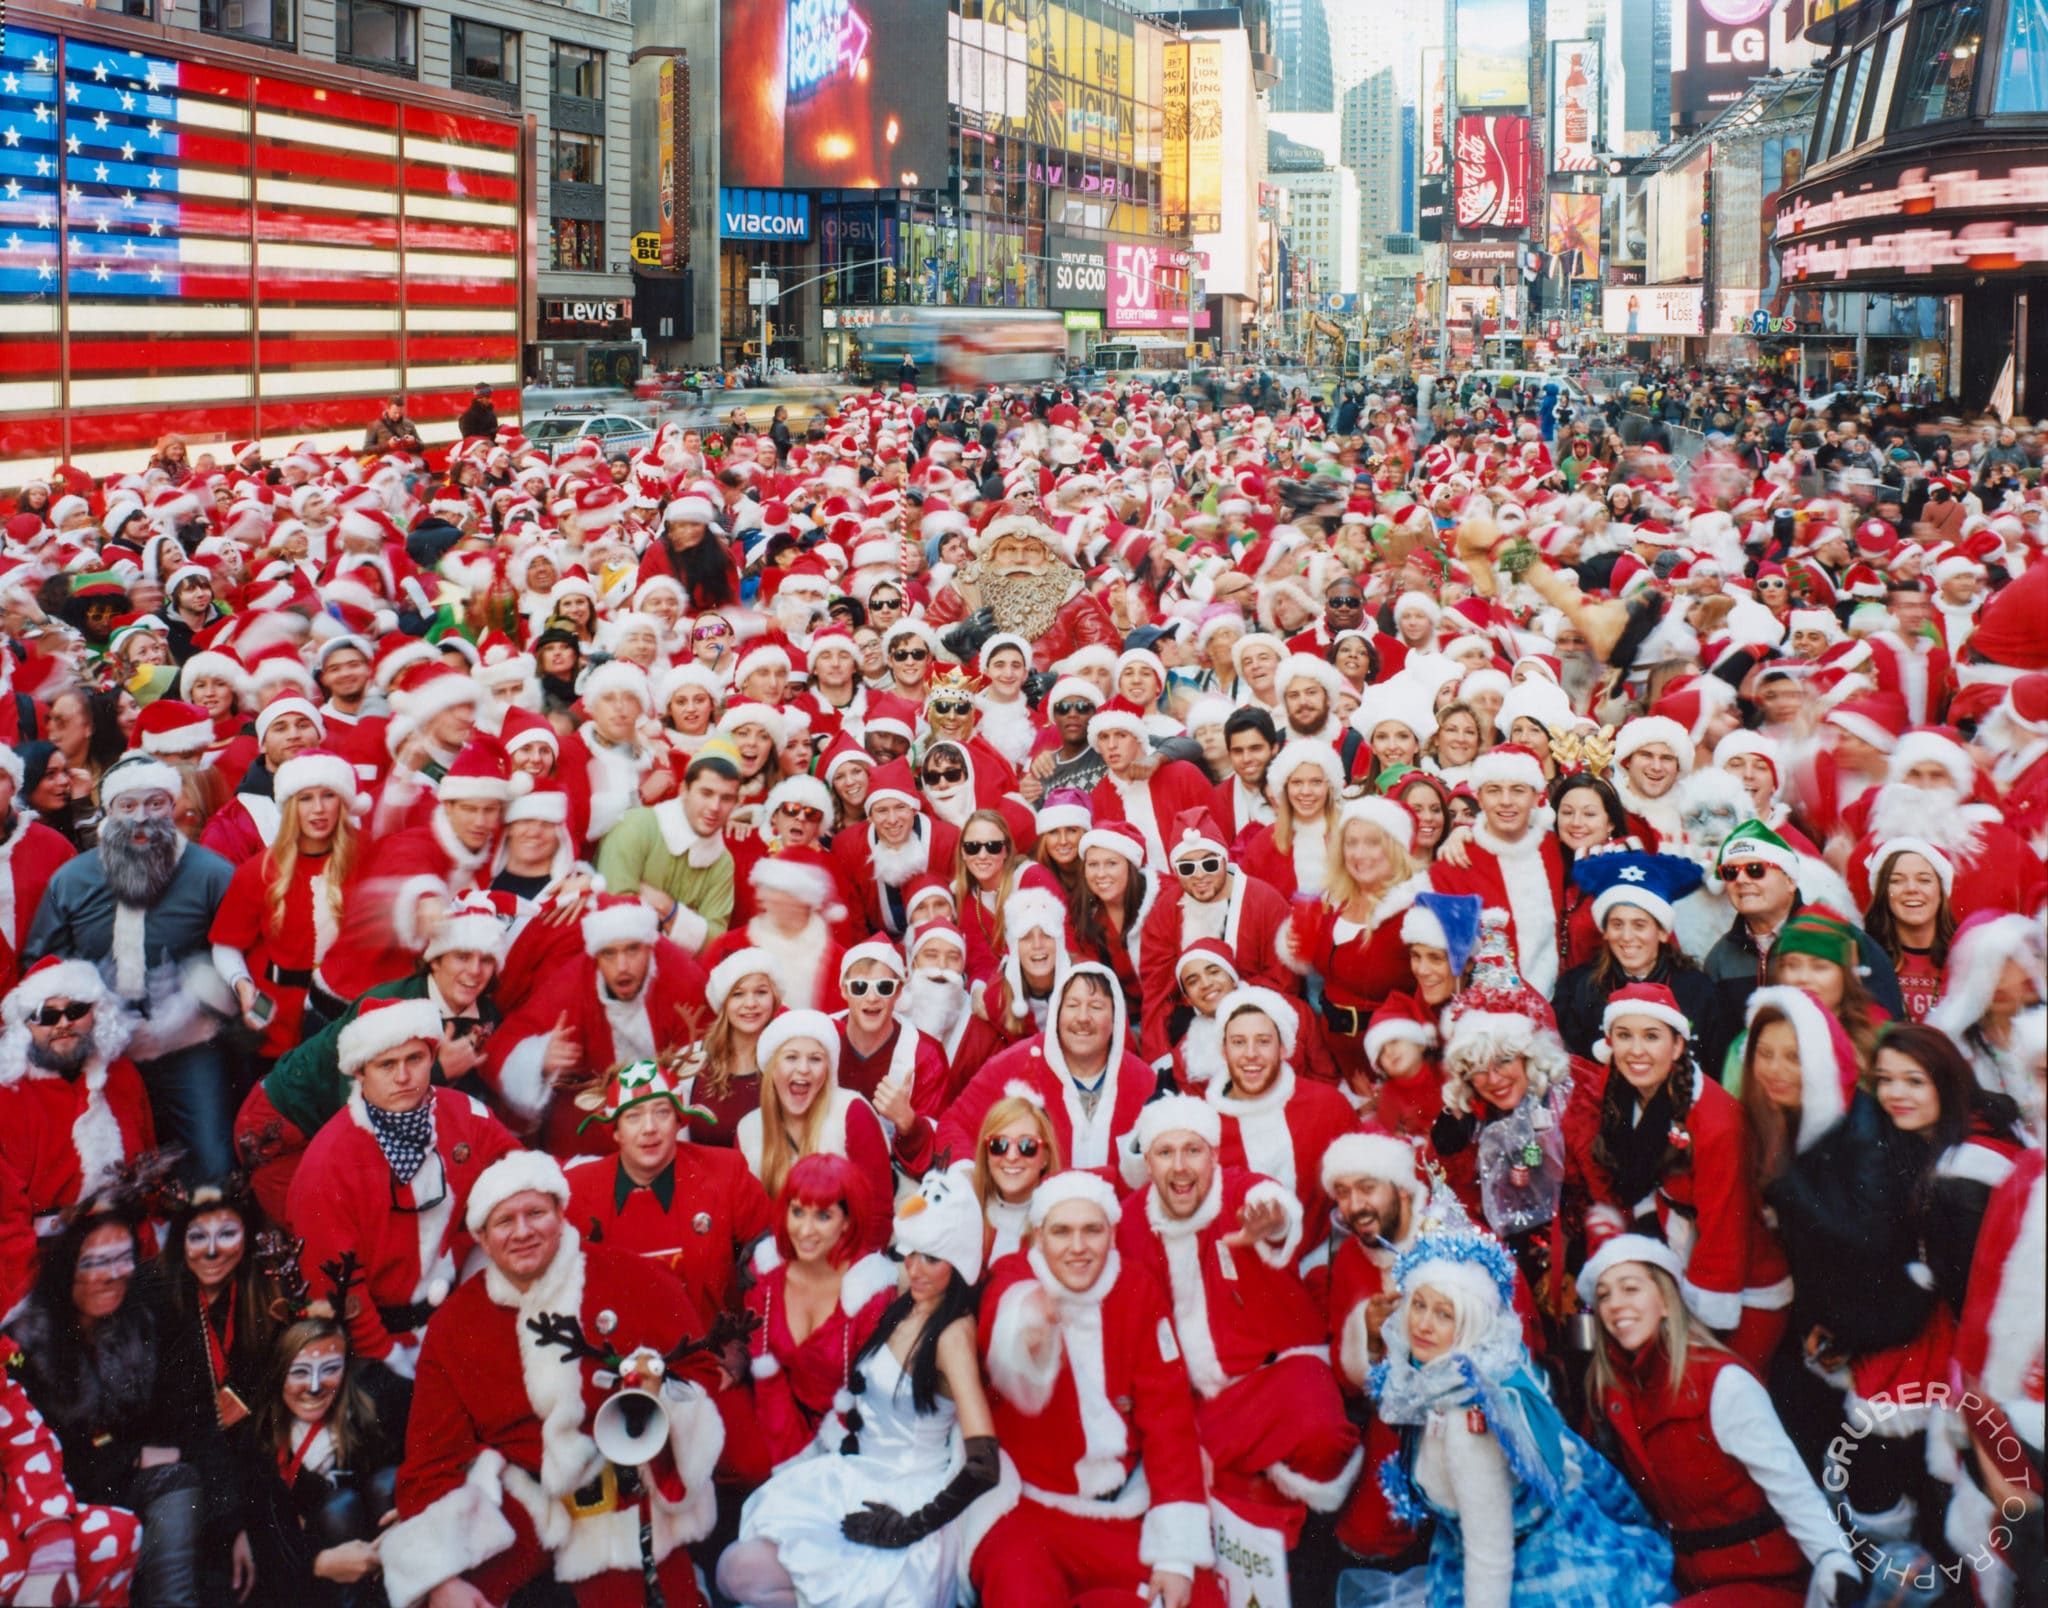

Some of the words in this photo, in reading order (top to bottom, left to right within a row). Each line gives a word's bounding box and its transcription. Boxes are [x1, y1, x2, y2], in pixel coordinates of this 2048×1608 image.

[1705, 28, 1765, 63] LG
[1196, 57, 1213, 65] THE
[1193, 67, 1218, 79] LION
[1192, 82, 1220, 95] KING
[637, 237, 660, 248] BE
[638, 249, 661, 259] BU
[1056, 267, 1073, 290] SO
[1116, 308, 1158, 320] EVERYTHING
[1218, 1524, 1274, 1578] Badges
